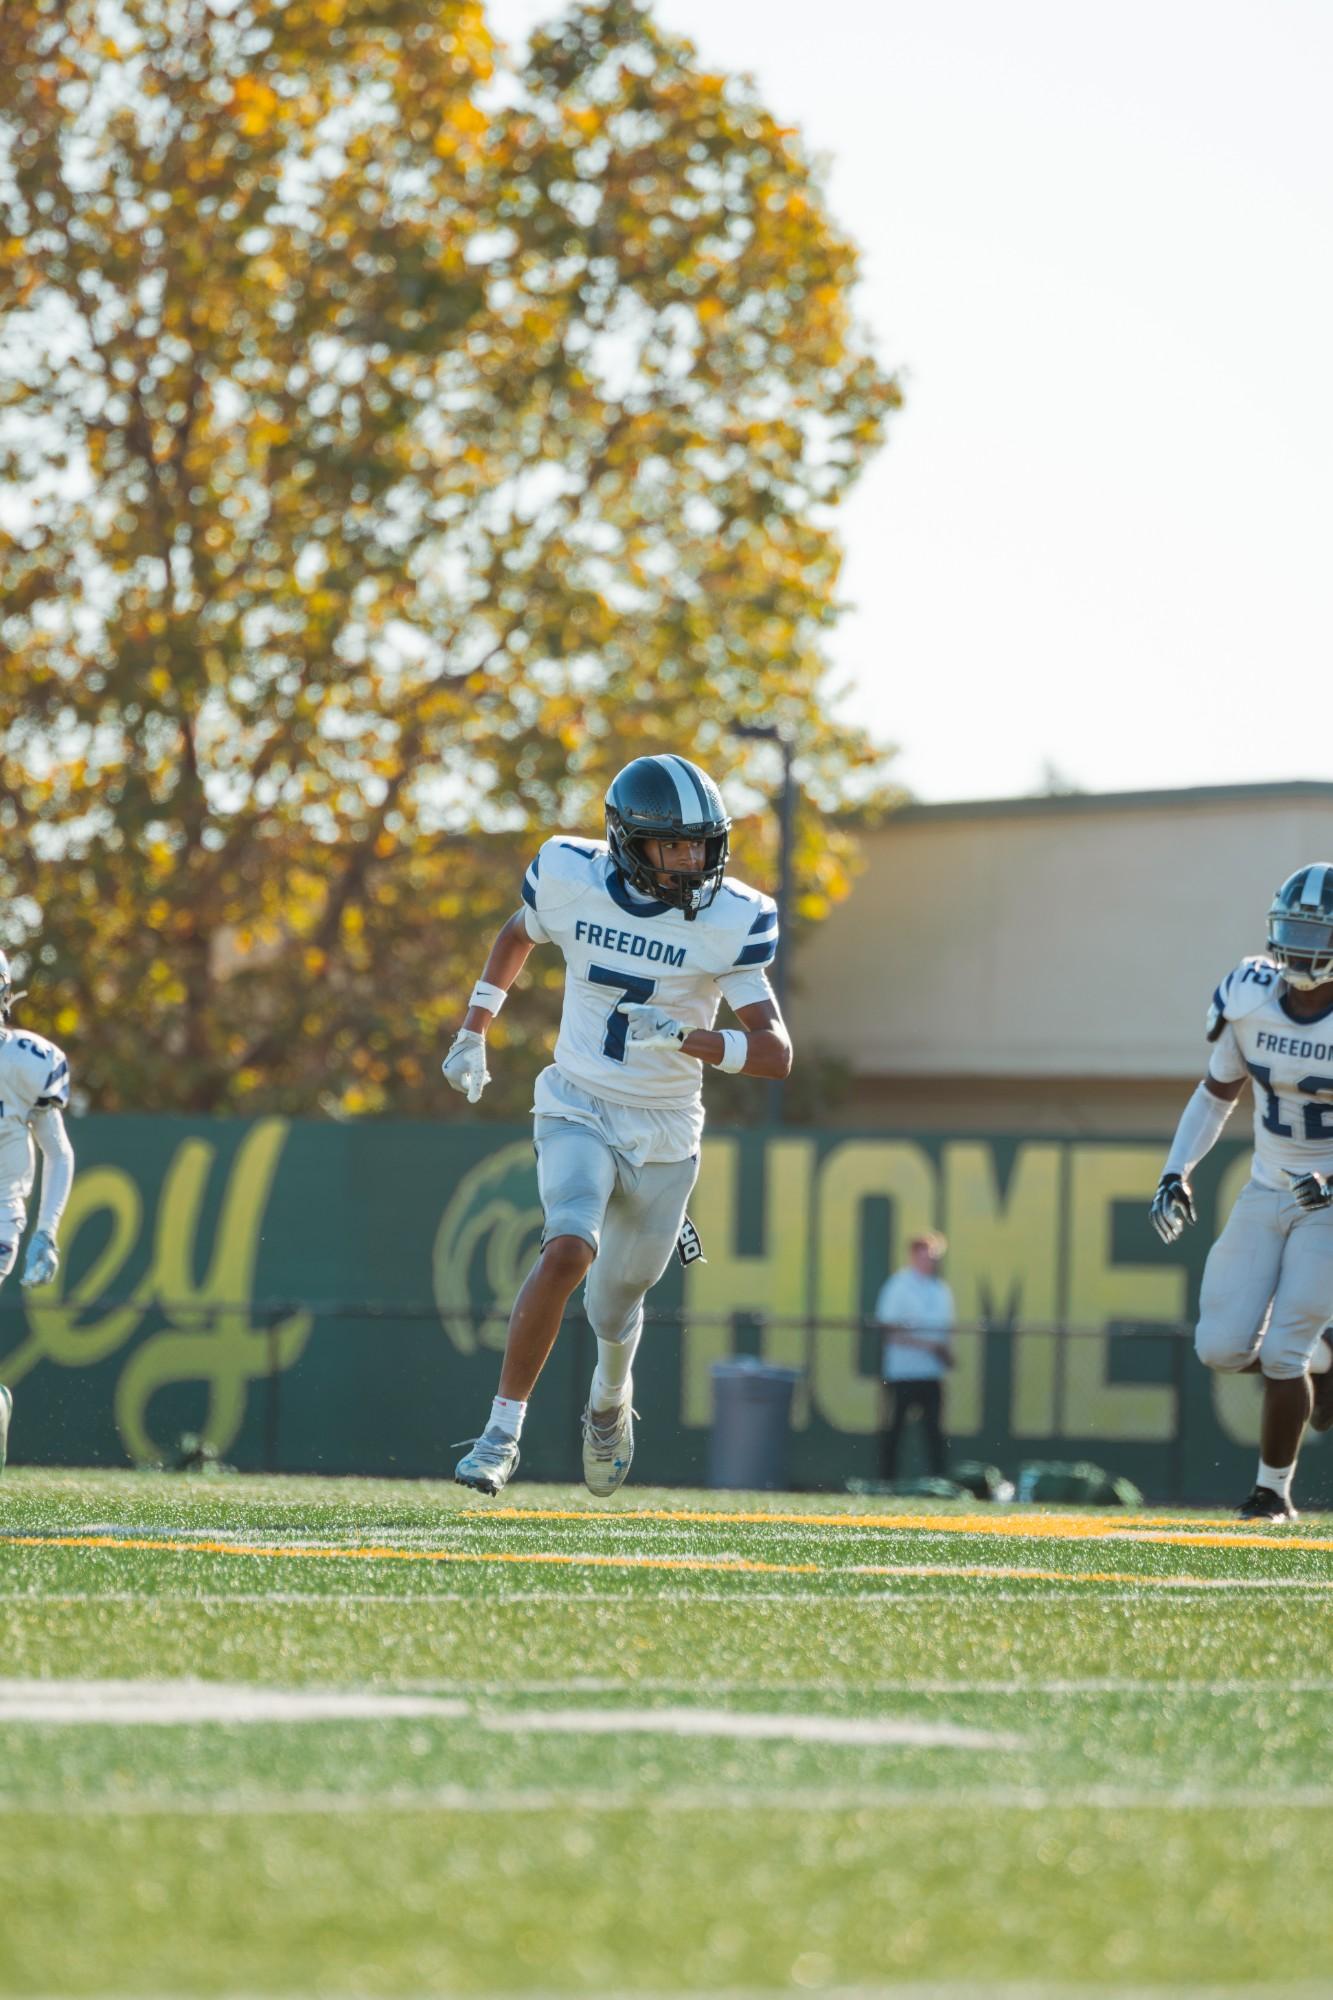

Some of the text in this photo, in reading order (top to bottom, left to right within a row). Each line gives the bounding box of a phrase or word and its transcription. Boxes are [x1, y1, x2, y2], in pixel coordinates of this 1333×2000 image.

[575, 920, 687, 968] FREEDOM
[586, 962, 658, 1064] 7
[1247, 1061, 1333, 1140] 12
[684, 1139, 1186, 1441] HOME
